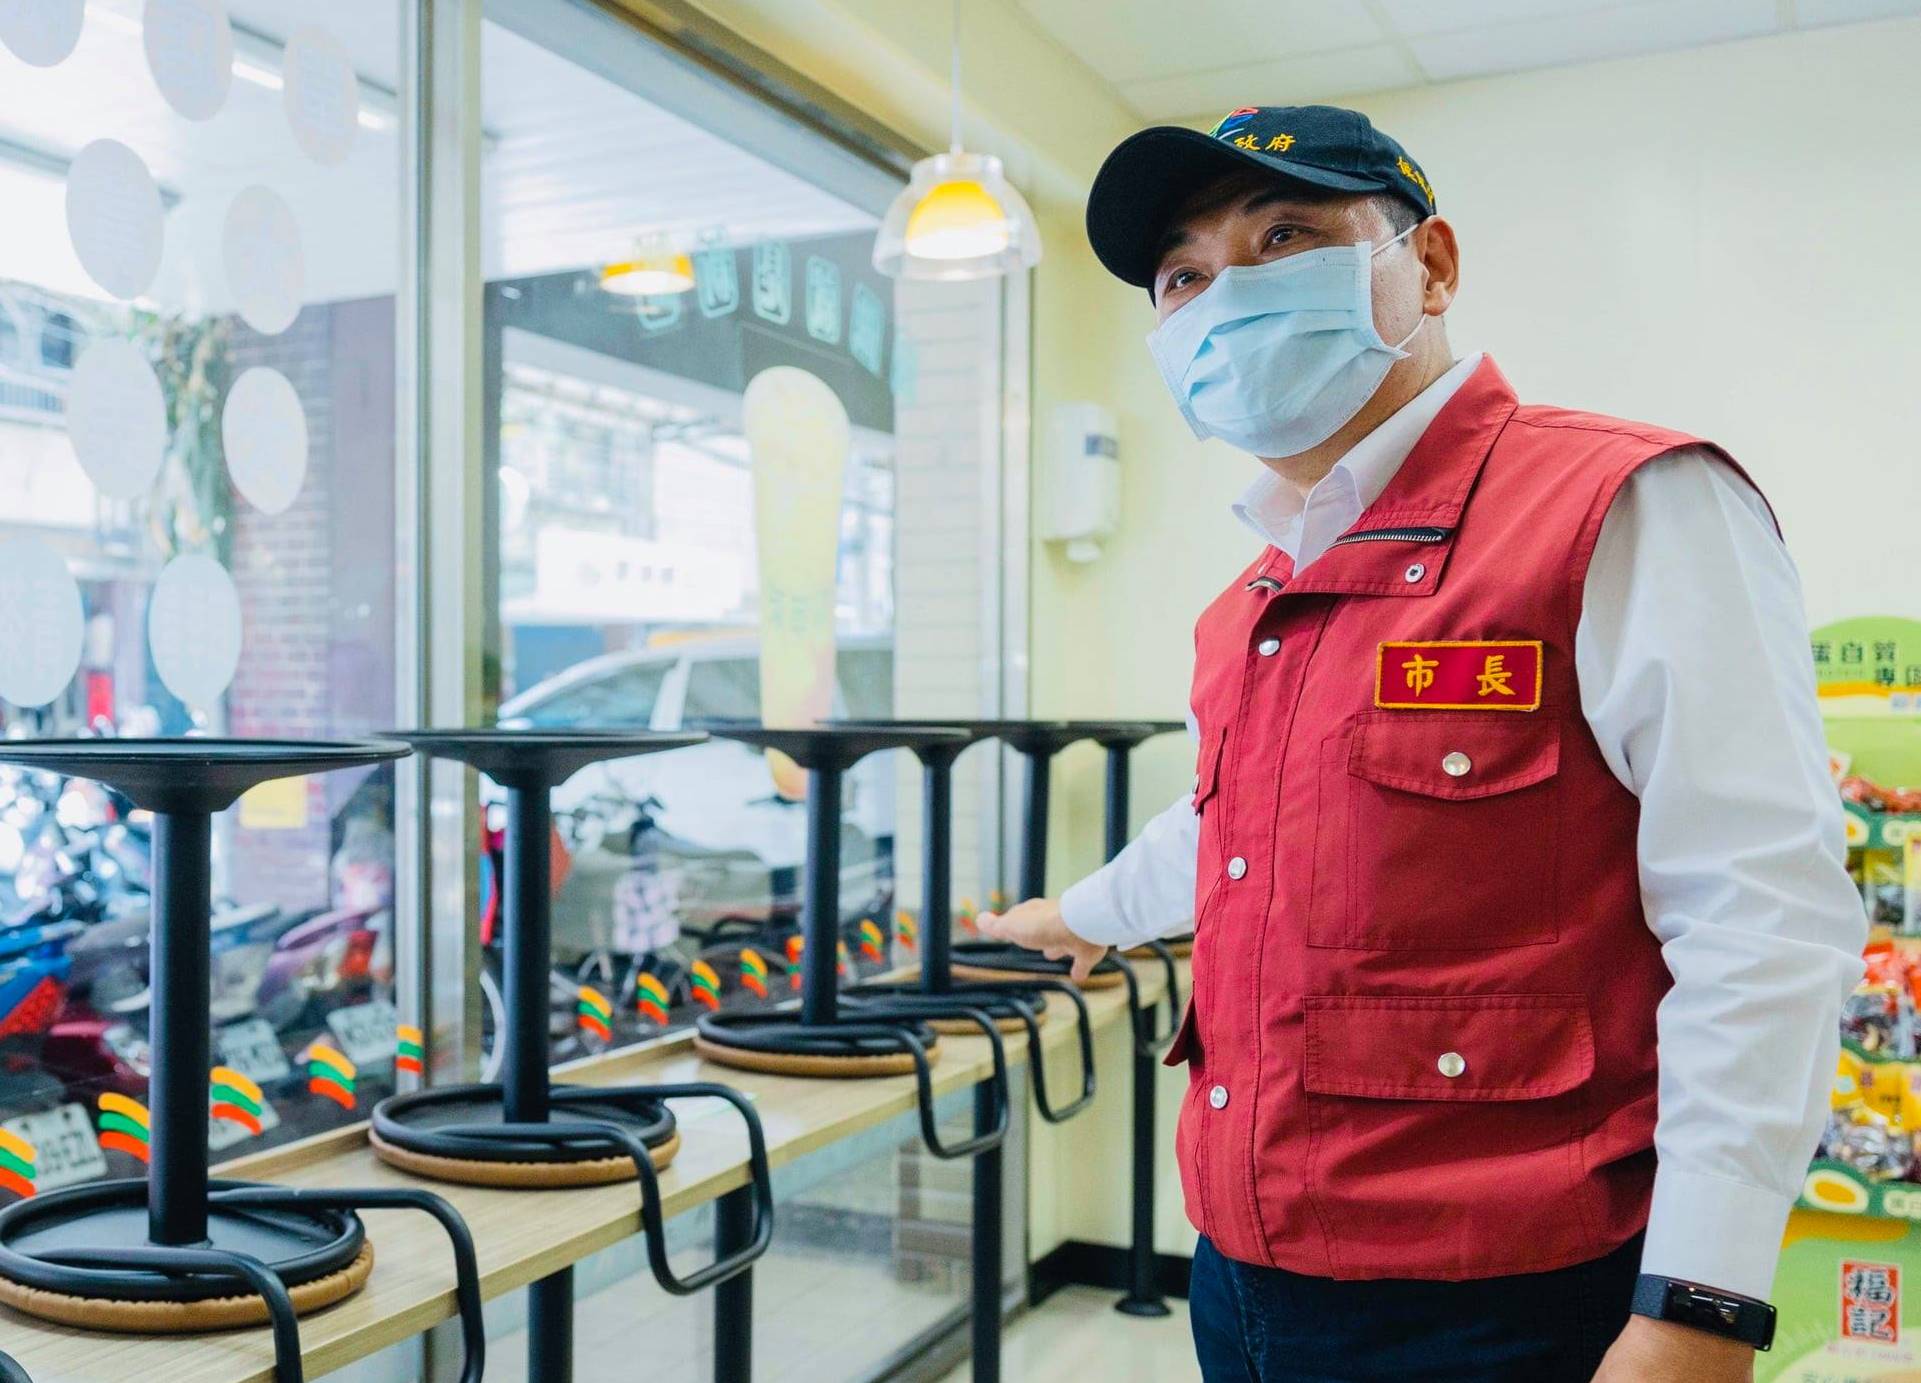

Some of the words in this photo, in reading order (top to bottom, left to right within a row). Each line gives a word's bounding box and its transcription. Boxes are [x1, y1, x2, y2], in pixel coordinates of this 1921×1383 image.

[1233, 132, 1296, 152] 政府
[1401, 653, 1517, 697] 市長
[1848, 1268, 1893, 1340] 福記
